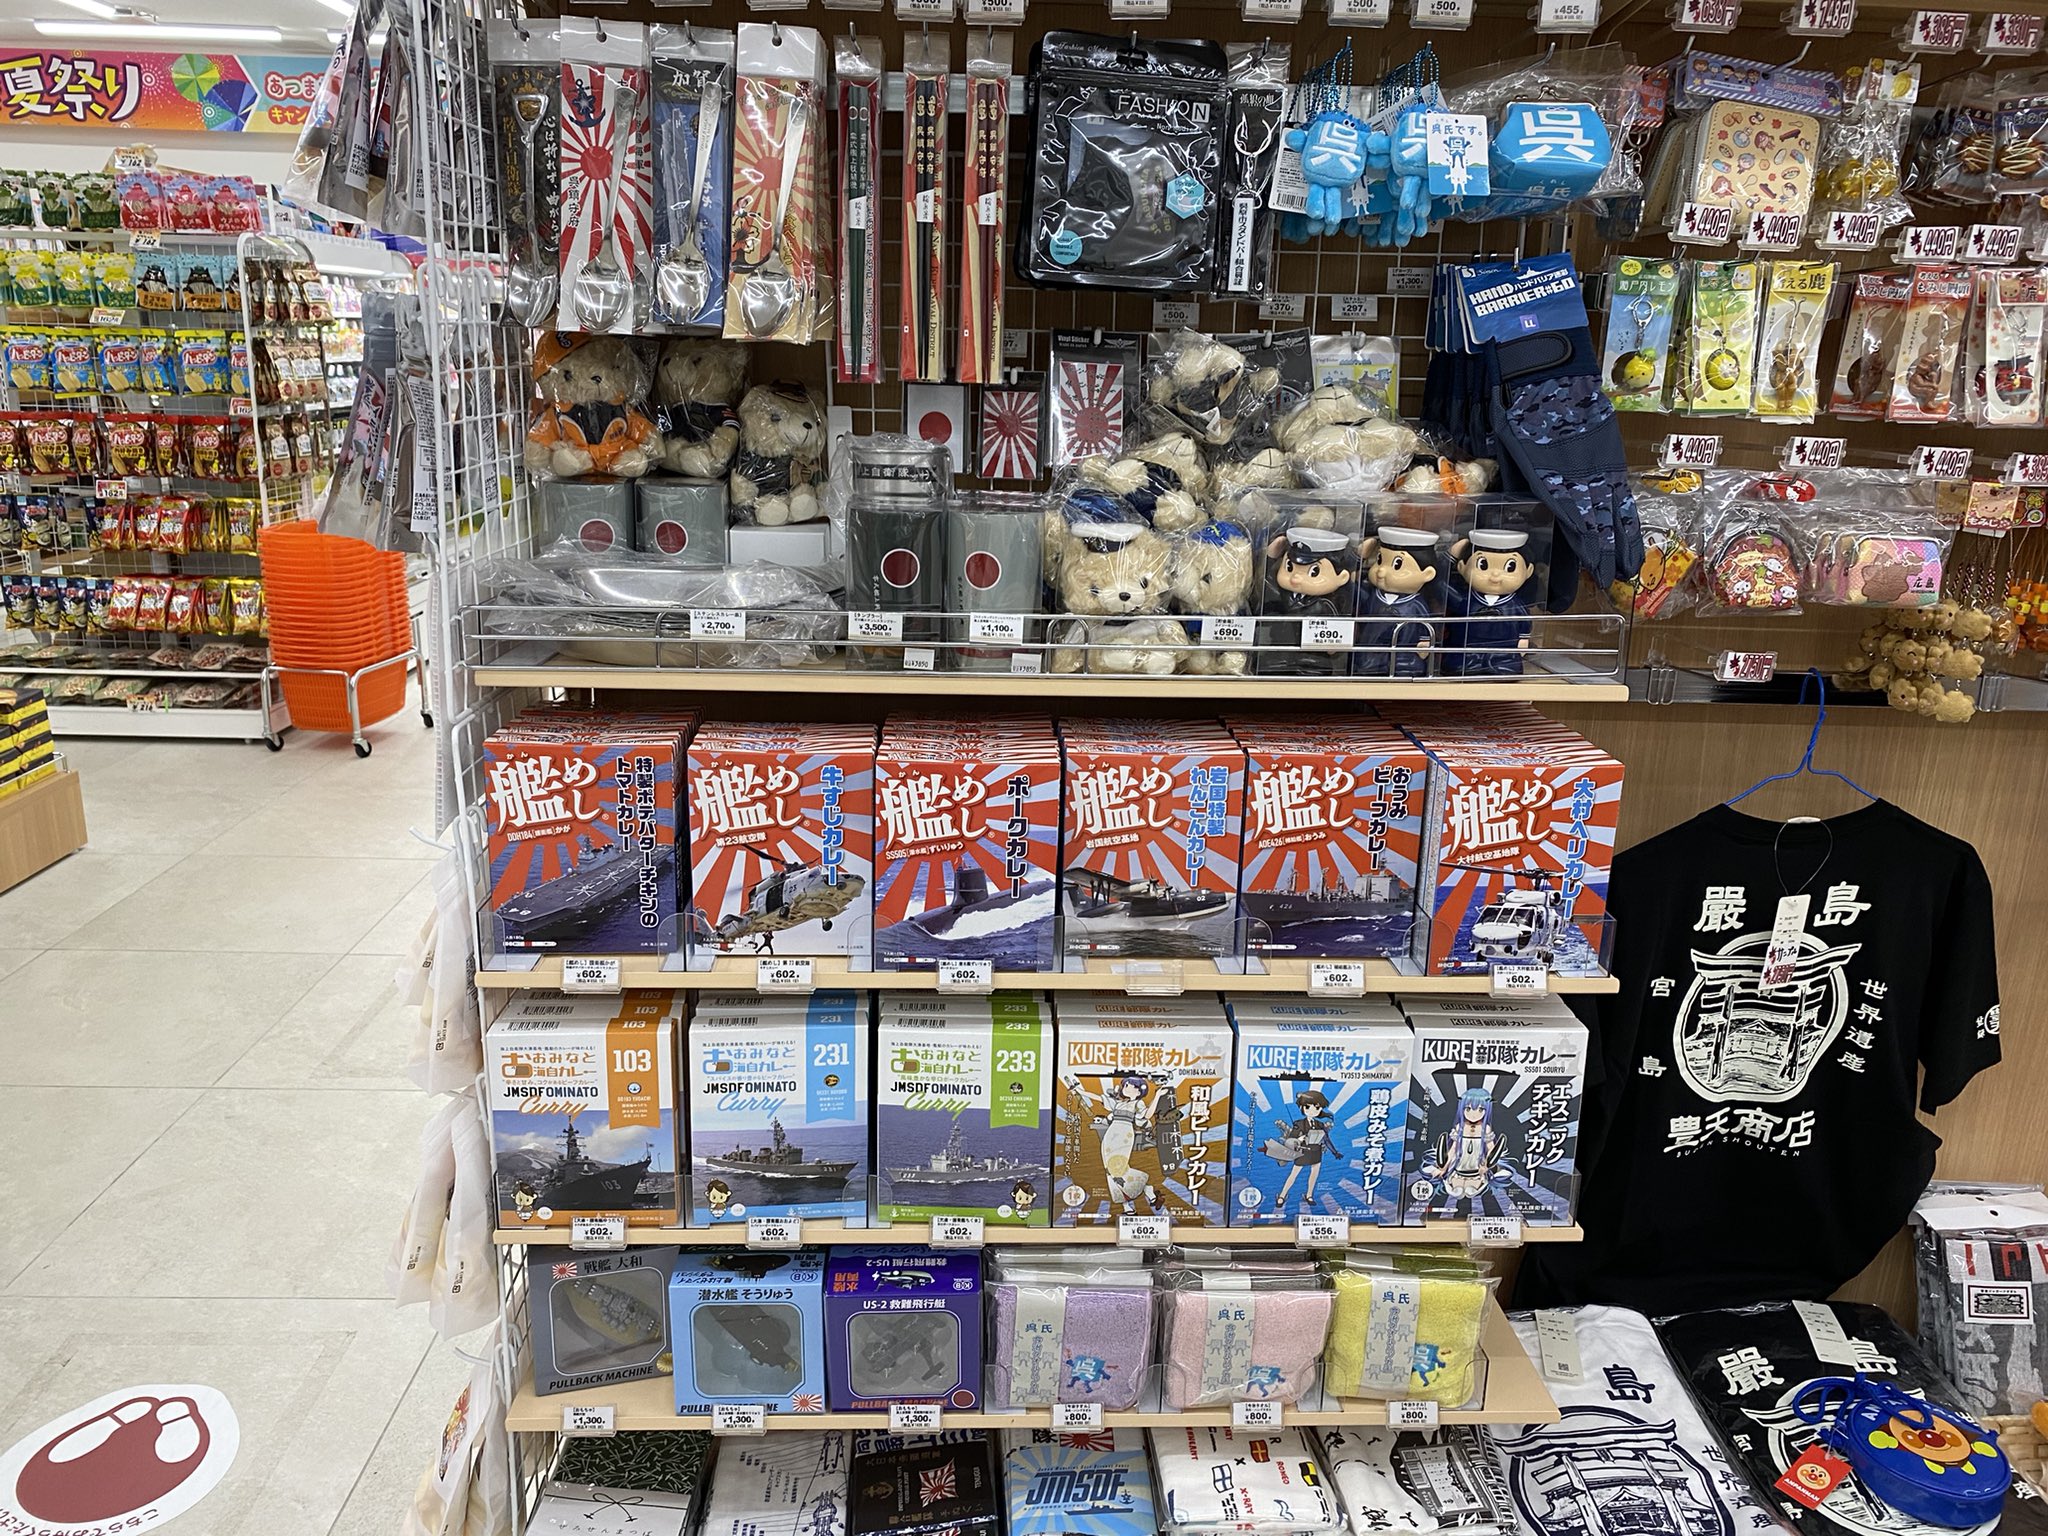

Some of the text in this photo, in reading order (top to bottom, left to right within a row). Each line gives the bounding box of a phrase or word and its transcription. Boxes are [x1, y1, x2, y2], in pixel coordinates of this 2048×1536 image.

[0, 54, 142, 122] 夏祭り
[671, 69, 711, 88] 加賀
[1431, 122, 1484, 137] 呉氏です。
[1518, 109, 1595, 164] 呉
[566, 175, 583, 229] 呉鎮守府
[1696, 207, 1733, 239] 440円
[1765, 214, 1800, 245] 440円
[1844, 214, 1880, 244] 440円
[1920, 227, 1957, 257] 440円
[1984, 227, 2019, 257] 440円
[1468, 282, 1515, 305] HAND
[1473, 276, 1576, 318] BARRIER#60
[1683, 439, 1715, 465] 440円
[1806, 440, 1841, 468] 440円
[1933, 450, 1969, 478] 440円
[490, 755, 601, 834] 艦めし
[615, 757, 636, 852] トマトカレー
[693, 763, 802, 839] 艦めし
[1070, 764, 1175, 840] 艦めし
[1207, 766, 1230, 837] 岩国特製
[1253, 764, 1356, 840] 艦めし
[1387, 766, 1412, 821] おうみ
[820, 764, 845, 887] 牛すじカレー
[880, 773, 989, 849] 艦めし
[1367, 766, 1392, 871] ビーフカレー
[1449, 777, 1554, 857] 艦めし
[636, 757, 660, 928] 特製ポテバターチキンの
[1006, 775, 1030, 899] ポークカレー
[1186, 766, 1208, 888] れんこんカレー
[1560, 777, 1597, 922] 大村ヘリカレー
[613, 1049, 652, 1073] 103
[734, 1061, 797, 1073] 海自カレー
[813, 1042, 850, 1066] 231
[996, 1049, 1036, 1073] 233
[1068, 1042, 1222, 1068] KURE 部隊カレー
[1248, 1045, 1403, 1072] KURE 部隊カレー
[1422, 1039, 1577, 1065] KURE 部隊カレー
[533, 1066, 597, 1078] 海自カレー
[920, 1063, 982, 1075] 海自カレー
[519, 1095, 589, 1122] Curry
[903, 1091, 972, 1121] Curry
[1525, 1083, 1553, 1189] チキンカレー
[1546, 1083, 1572, 1165] エスニック
[1663, 1106, 1816, 1154] 豊天商店
[1186, 1085, 1213, 1206] 和風ビーフカレー
[1363, 1088, 1392, 1205] 鶏皮みそ煮カレー
[583, 1255, 643, 1273] 戦艦 大和
[698, 1288, 794, 1301] 潜水艦 そうりゅう
[863, 1298, 946, 1309] US-2 救難飛行艇
[1382, 1291, 1410, 1304] 呉氏
[1217, 1308, 1246, 1321] 呉氏
[549, 1365, 654, 1391] PULLBACK MACHINE
[1025, 1468, 1129, 1506] JMSDF
